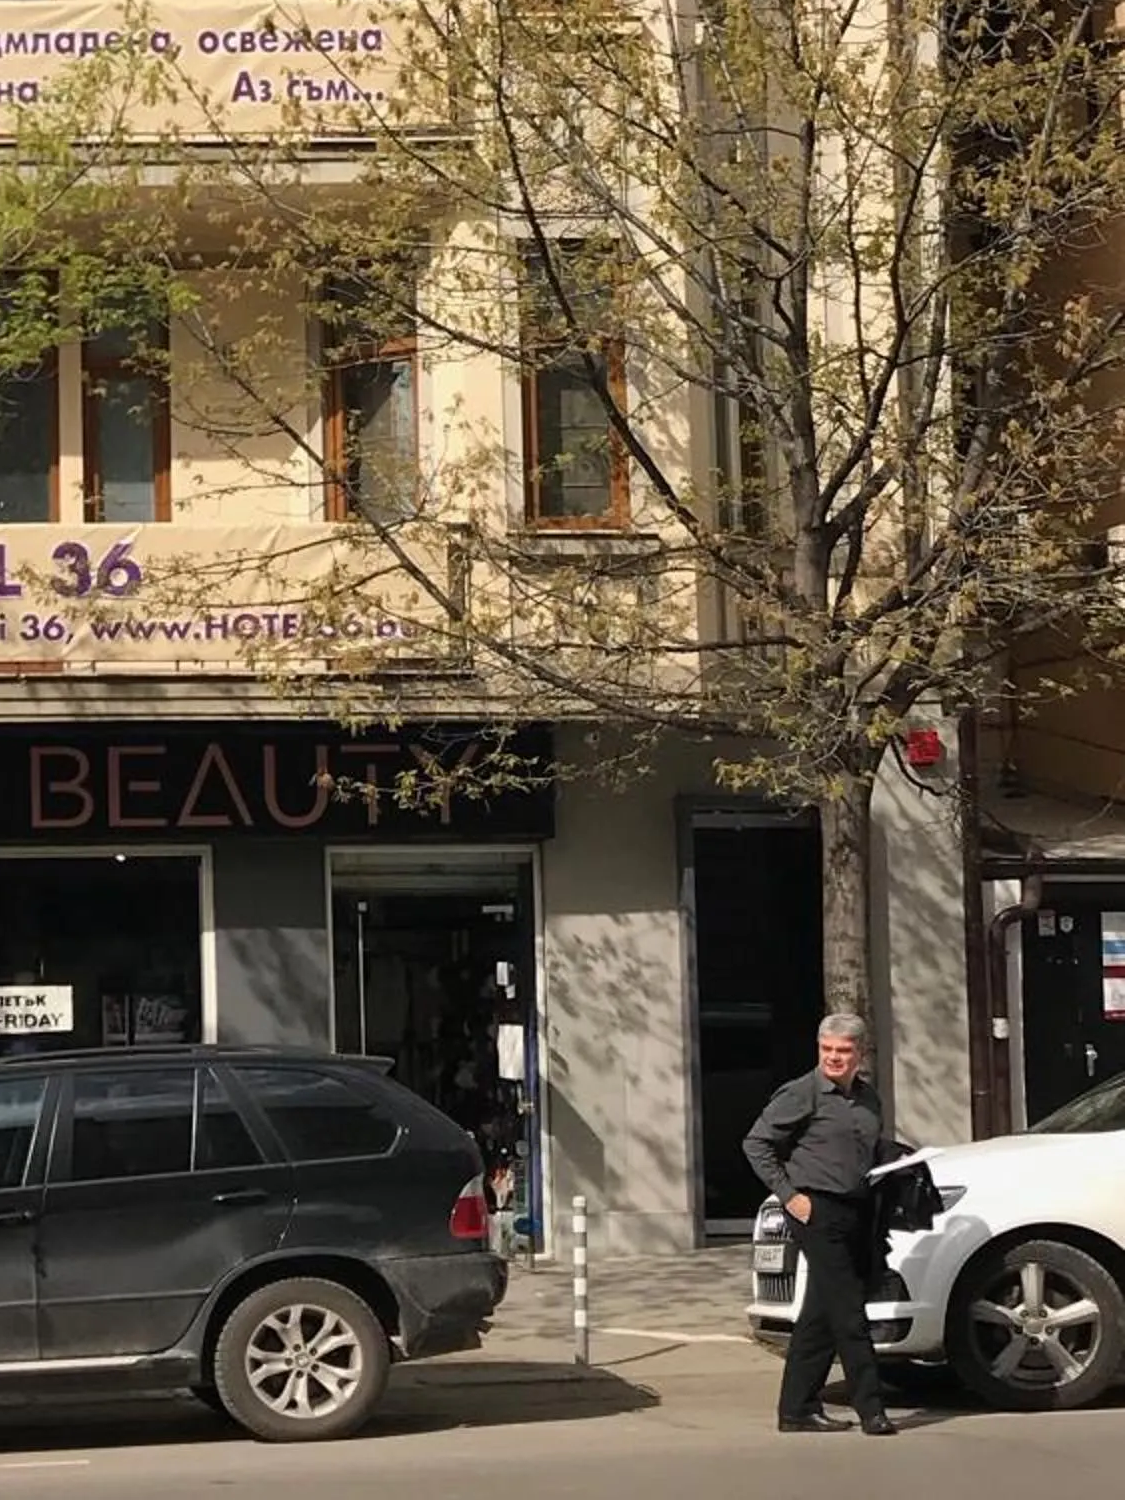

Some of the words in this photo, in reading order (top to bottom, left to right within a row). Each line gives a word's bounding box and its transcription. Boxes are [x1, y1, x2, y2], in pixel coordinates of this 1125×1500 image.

[199, 26, 383, 55] освежена
[231, 71, 273, 102] Аз
[51, 541, 142, 598] 36
[20, 613, 74, 646] 36,
[29, 742, 479, 828] BEAUTY
